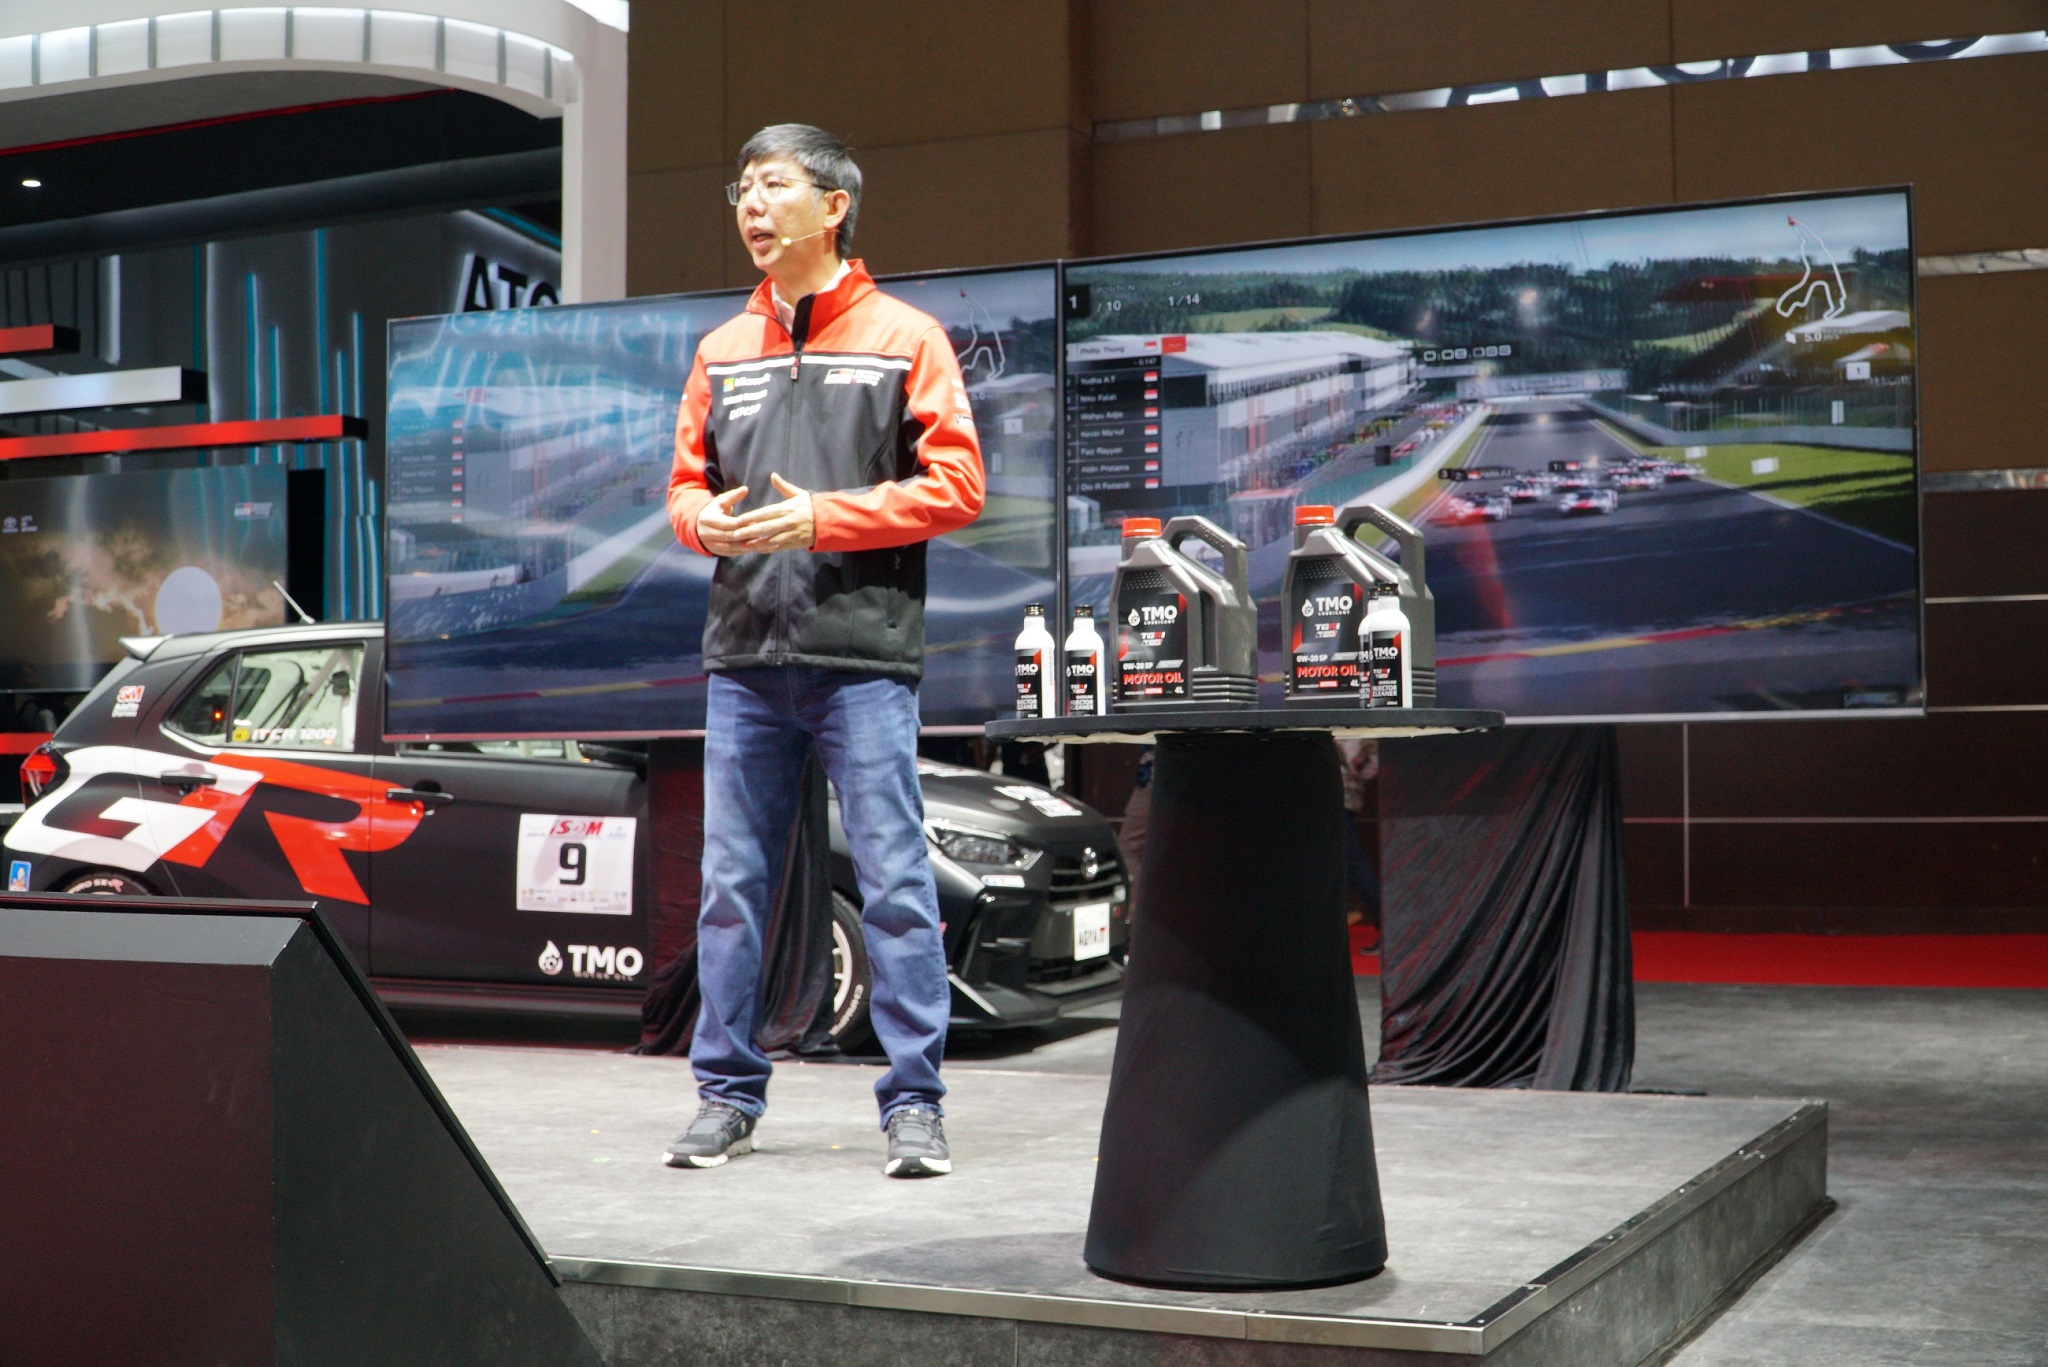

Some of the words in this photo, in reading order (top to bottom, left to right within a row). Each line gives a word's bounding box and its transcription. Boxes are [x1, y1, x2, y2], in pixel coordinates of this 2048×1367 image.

[1316, 596, 1353, 611] TMO
[1141, 605, 1178, 621] TMO
[1373, 647, 1398, 657] TMO
[1017, 664, 1039, 673] TMO
[1071, 664, 1095, 674] TMO
[1297, 666, 1339, 678] MOTOR
[1340, 665, 1360, 676] OIL
[1123, 673, 1164, 685] MOTOR
[1164, 672, 1184, 684] OIL
[1350, 679, 1360, 687] 4L
[1174, 686, 1184, 694] 4L
[3, 746, 425, 906] GR
[559, 842, 587, 886] 9
[567, 944, 643, 977] TMO
